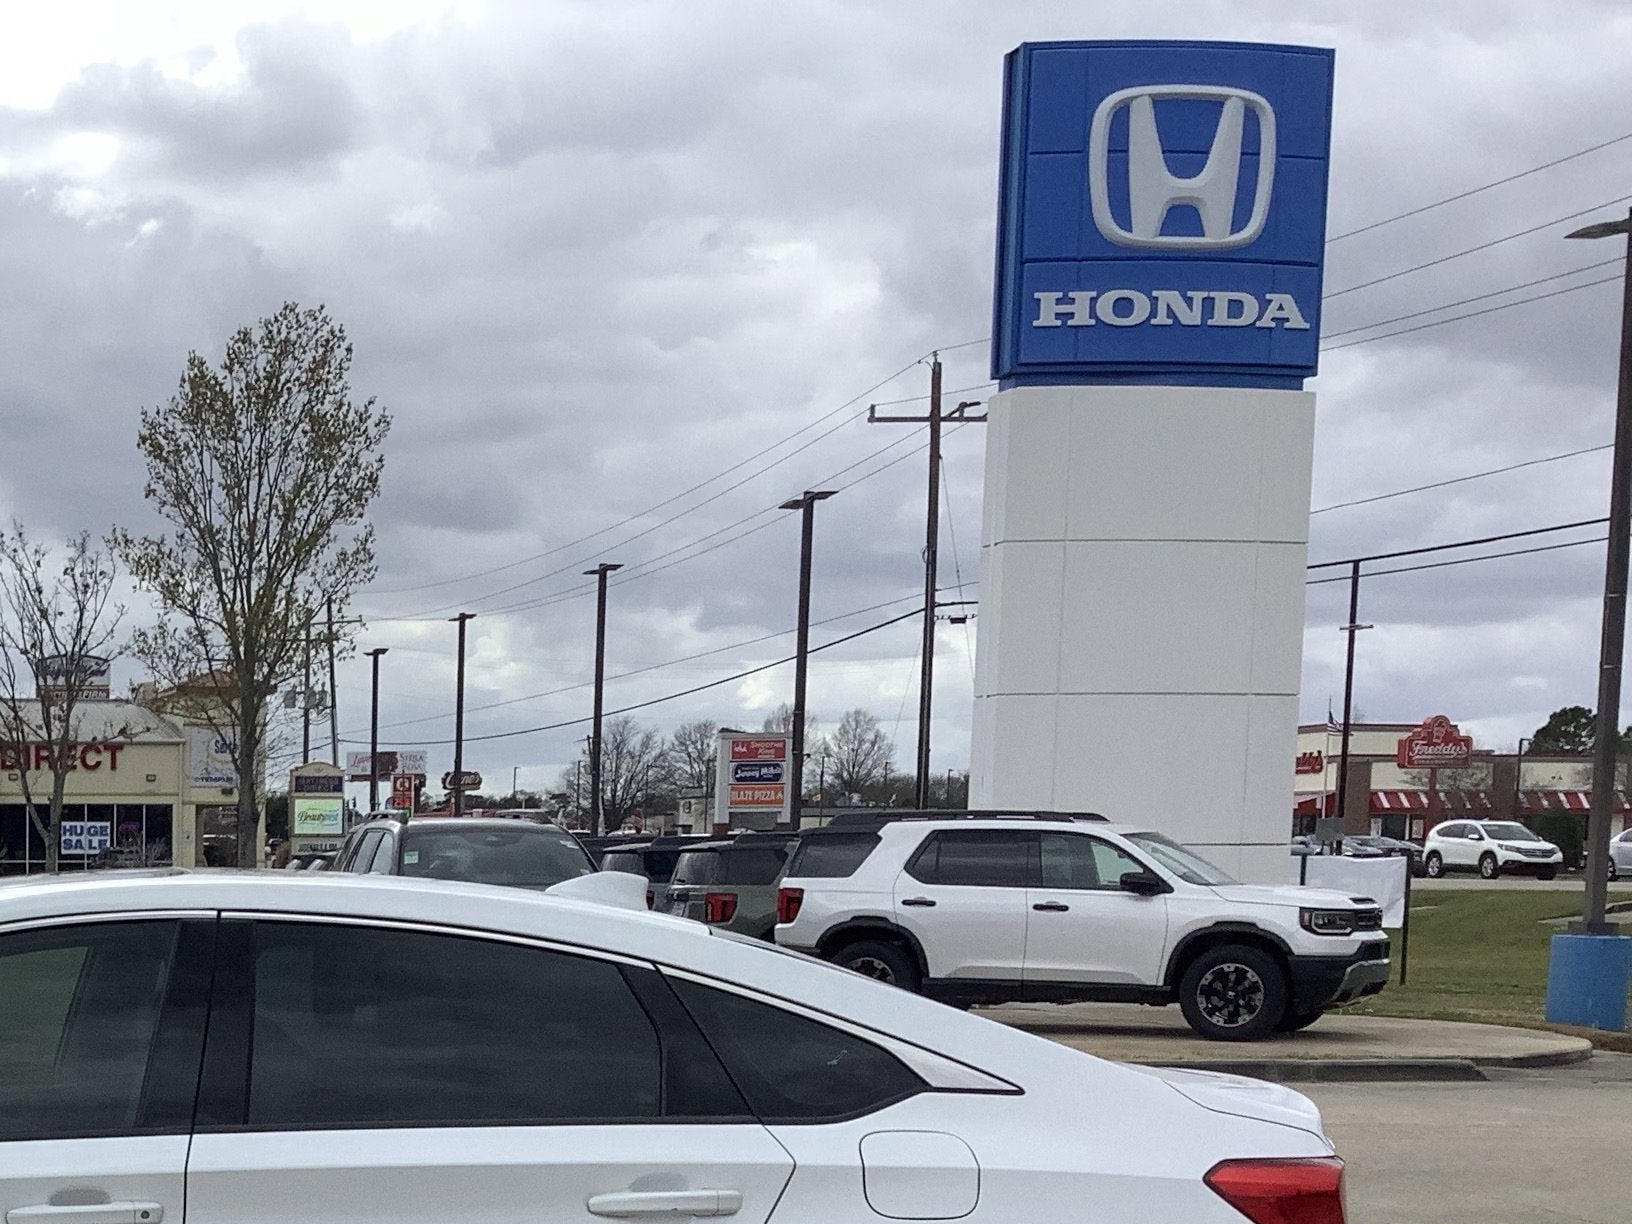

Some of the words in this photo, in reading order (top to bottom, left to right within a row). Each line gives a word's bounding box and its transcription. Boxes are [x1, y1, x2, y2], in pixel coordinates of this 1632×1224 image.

[1032, 289, 1311, 330] HONDA
[1409, 740, 1469, 758] Freddy's
[754, 790, 775, 801] PIZZA
[63, 825, 109, 837] HUGE
[63, 838, 108, 850] SALE
